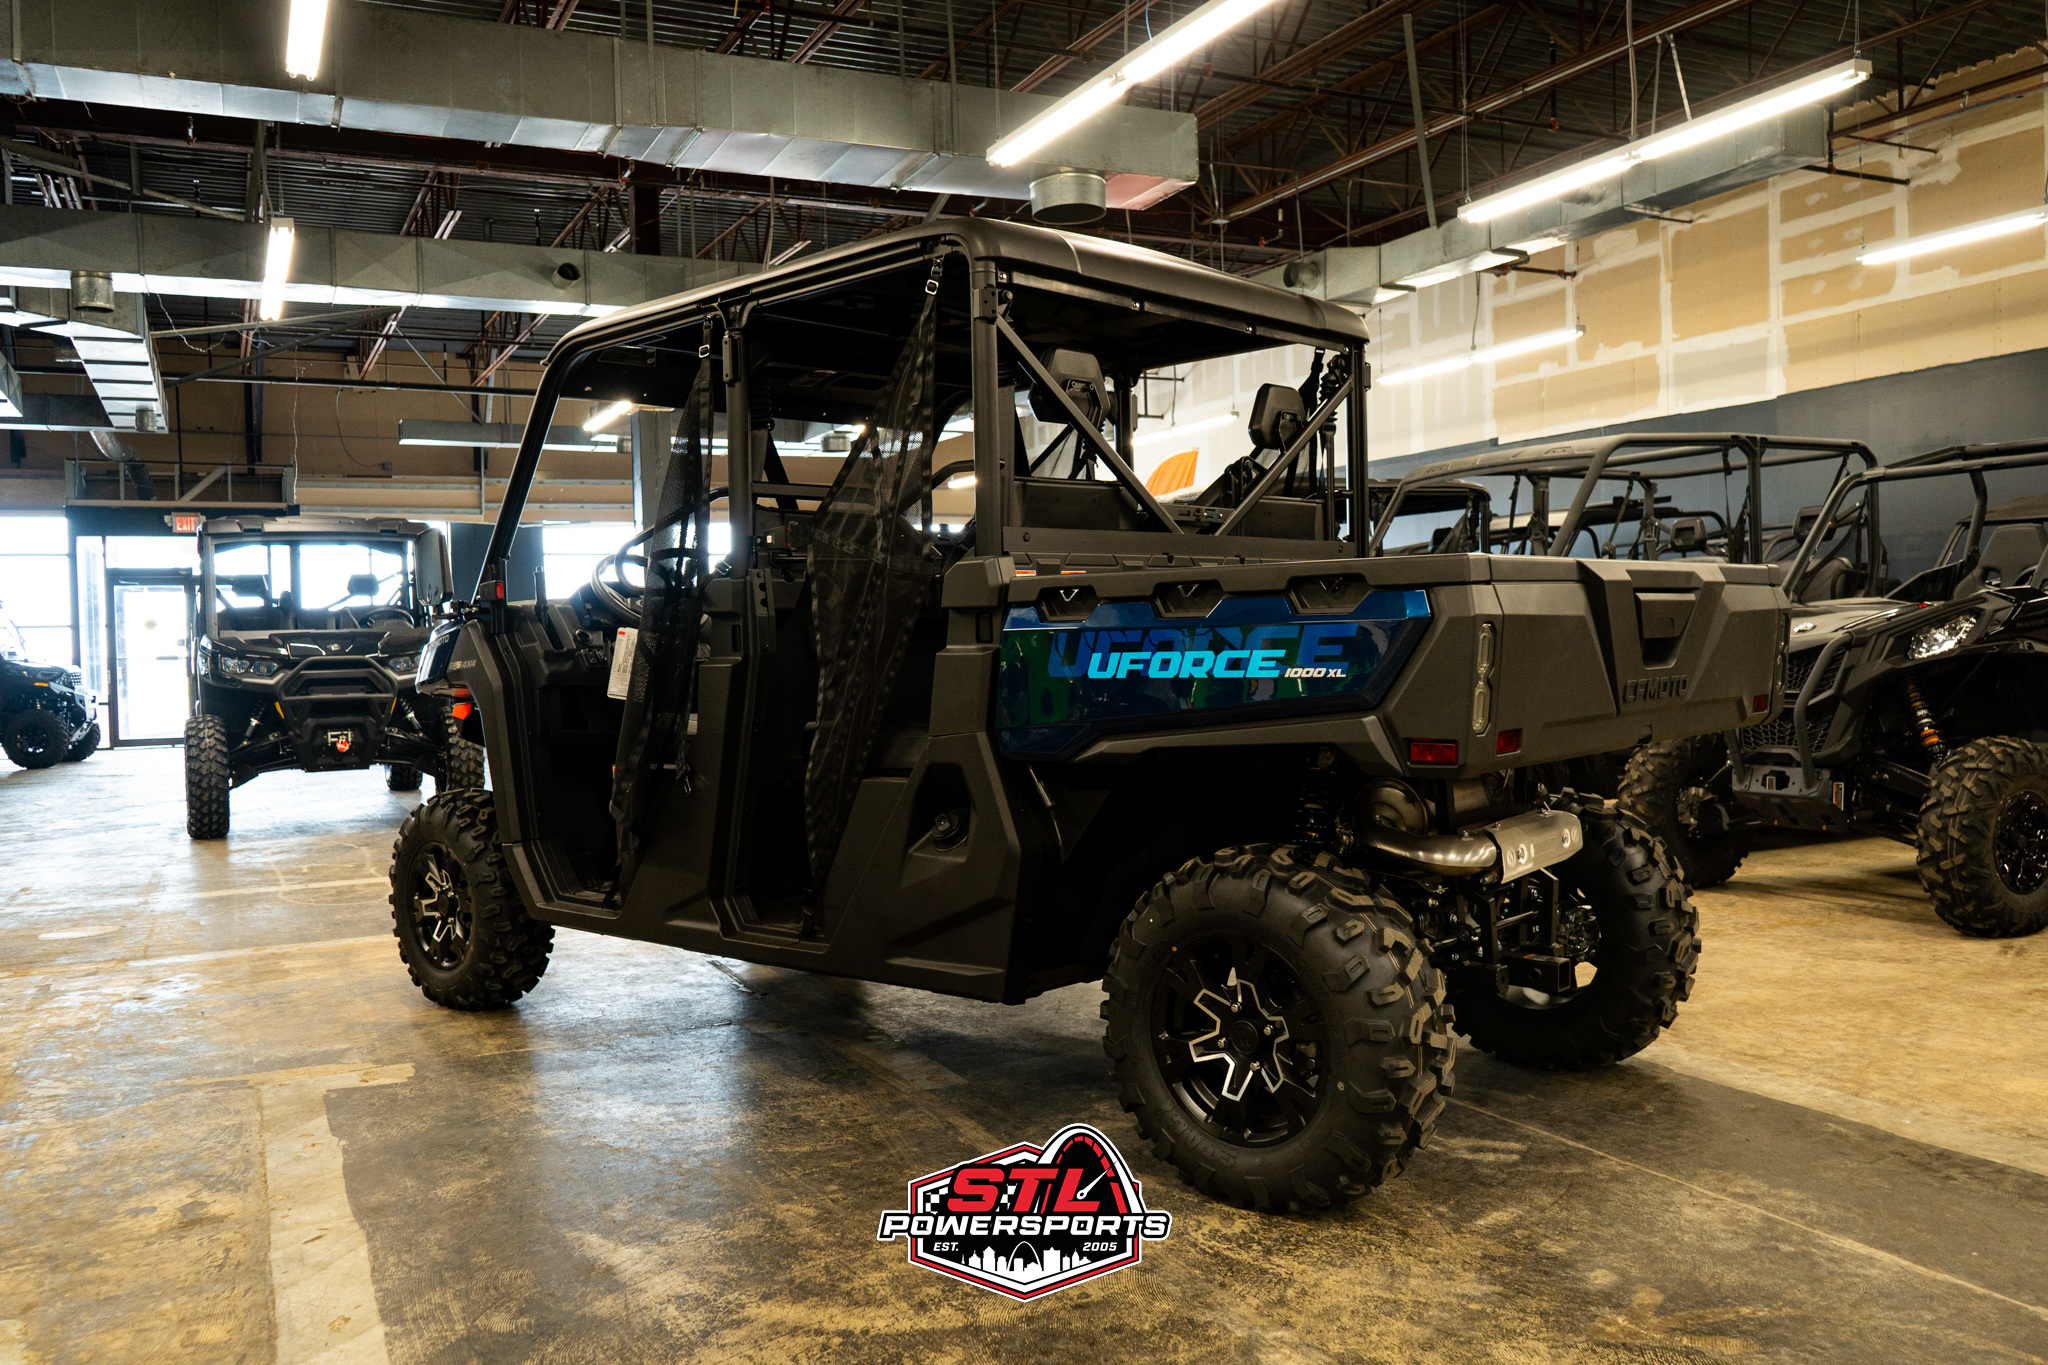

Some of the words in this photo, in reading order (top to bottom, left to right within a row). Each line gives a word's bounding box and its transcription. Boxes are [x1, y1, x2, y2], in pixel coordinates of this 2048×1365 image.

[176, 516, 196, 531] EXIT
[462, 659, 476, 668] 4X4
[1088, 650, 1286, 679] UFORCE
[1284, 667, 1327, 678] 1000
[1326, 668, 1347, 678] XL
[1624, 675, 1688, 702] CFMOTO
